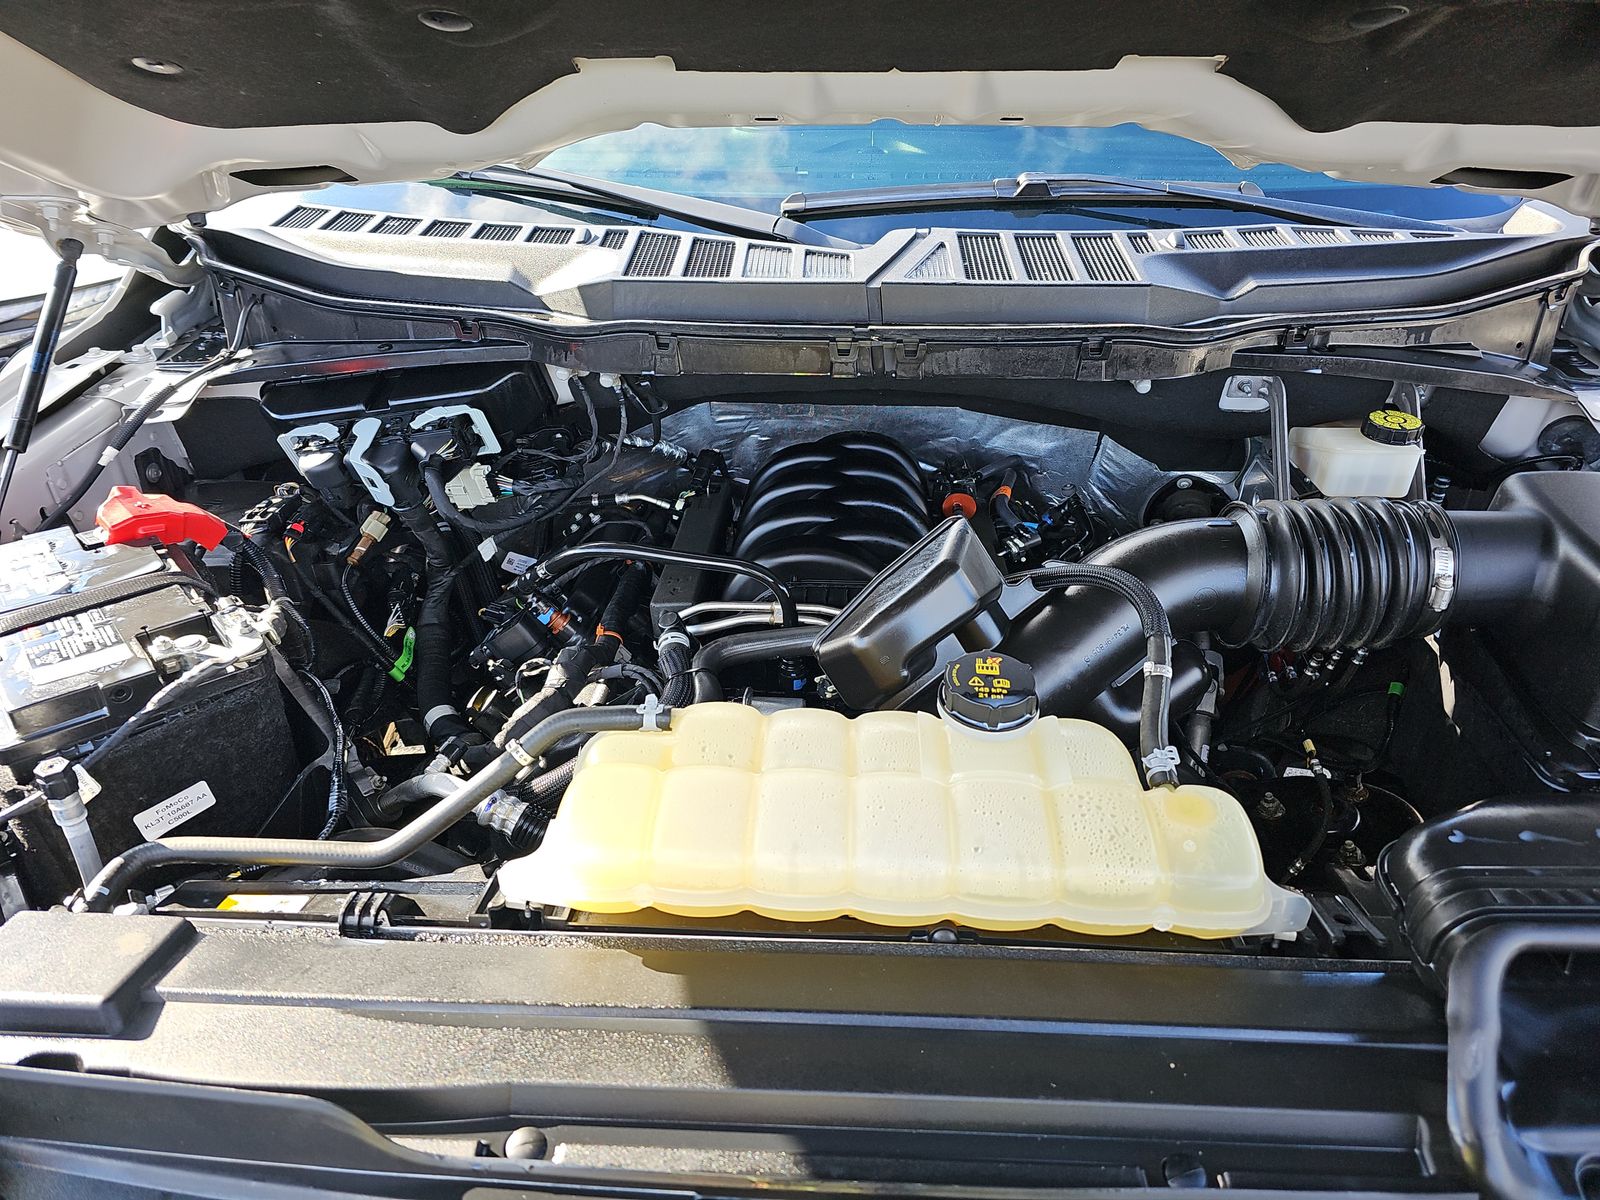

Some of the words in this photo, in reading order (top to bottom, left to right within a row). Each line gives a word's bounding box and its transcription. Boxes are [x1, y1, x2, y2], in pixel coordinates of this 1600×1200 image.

[144, 816, 165, 831] KL3T
[167, 800, 194, 818] 10A687
[196, 792, 208, 802] AA
[155, 795, 189, 815] FoMoCo
[167, 809, 193, 826] C500L
